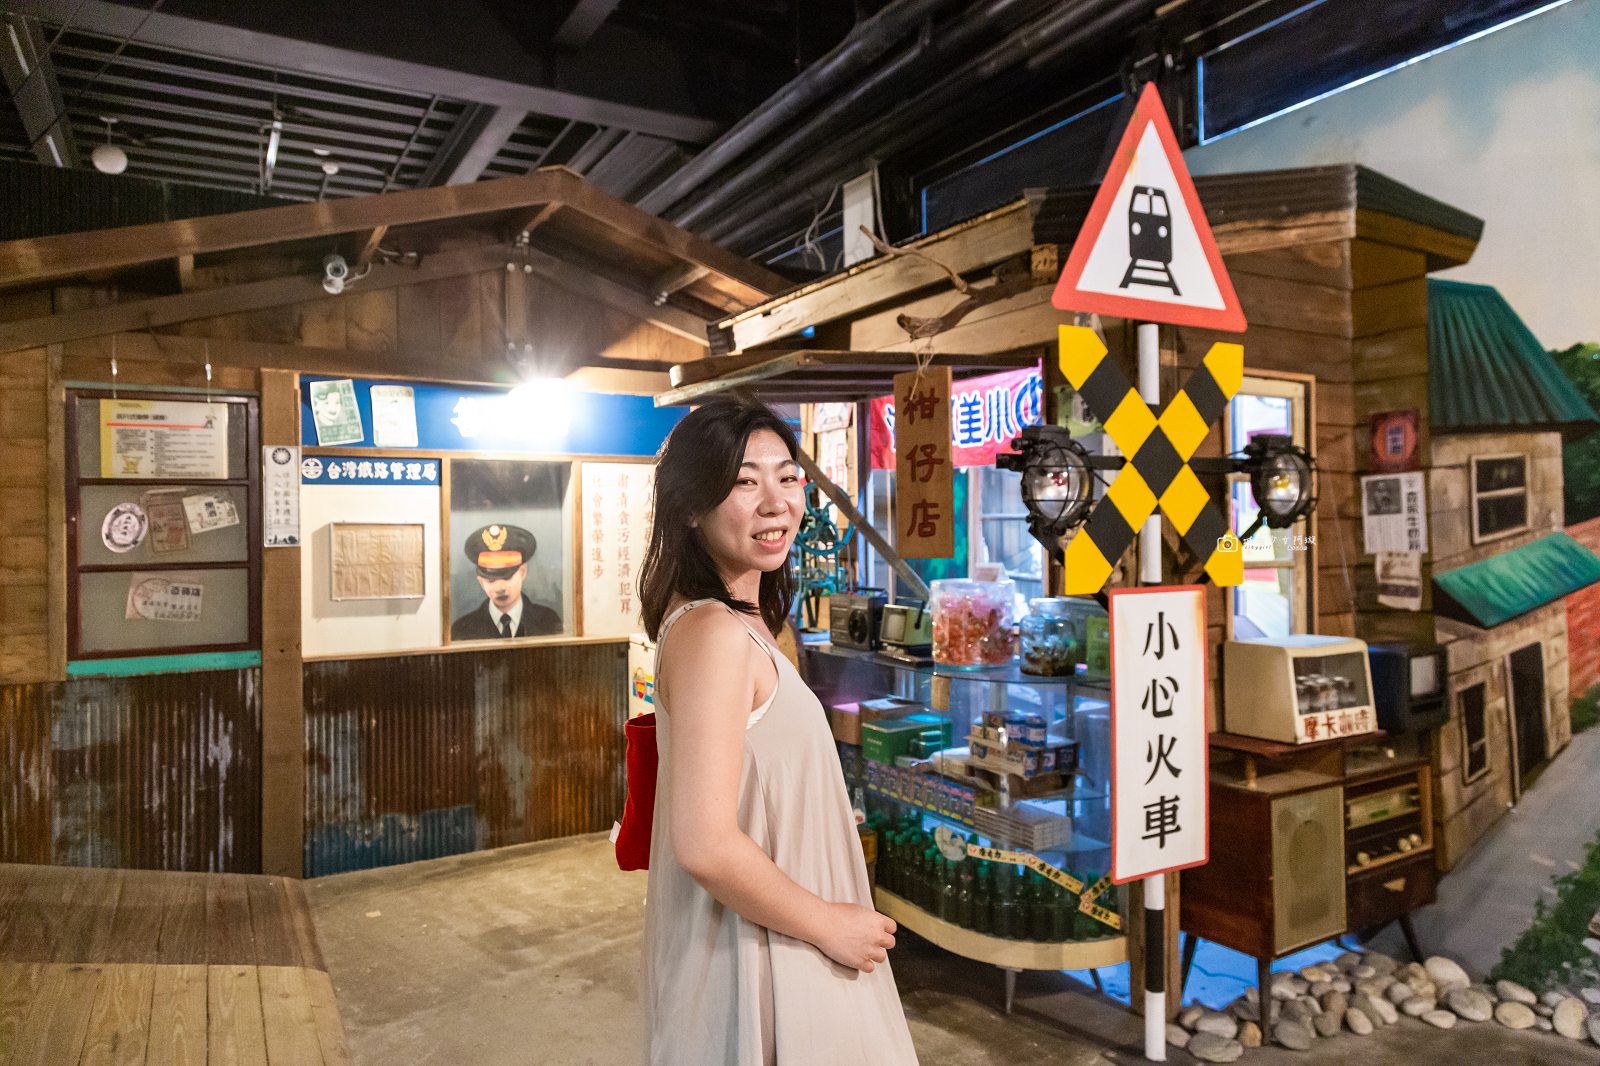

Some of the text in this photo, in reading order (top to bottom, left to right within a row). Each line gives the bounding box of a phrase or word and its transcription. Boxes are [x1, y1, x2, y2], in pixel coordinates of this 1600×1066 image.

[327, 461, 437, 481] 台灣鐵路管理局
[902, 386, 944, 538] 柑仔店
[1141, 611, 1182, 849] 小心火車
